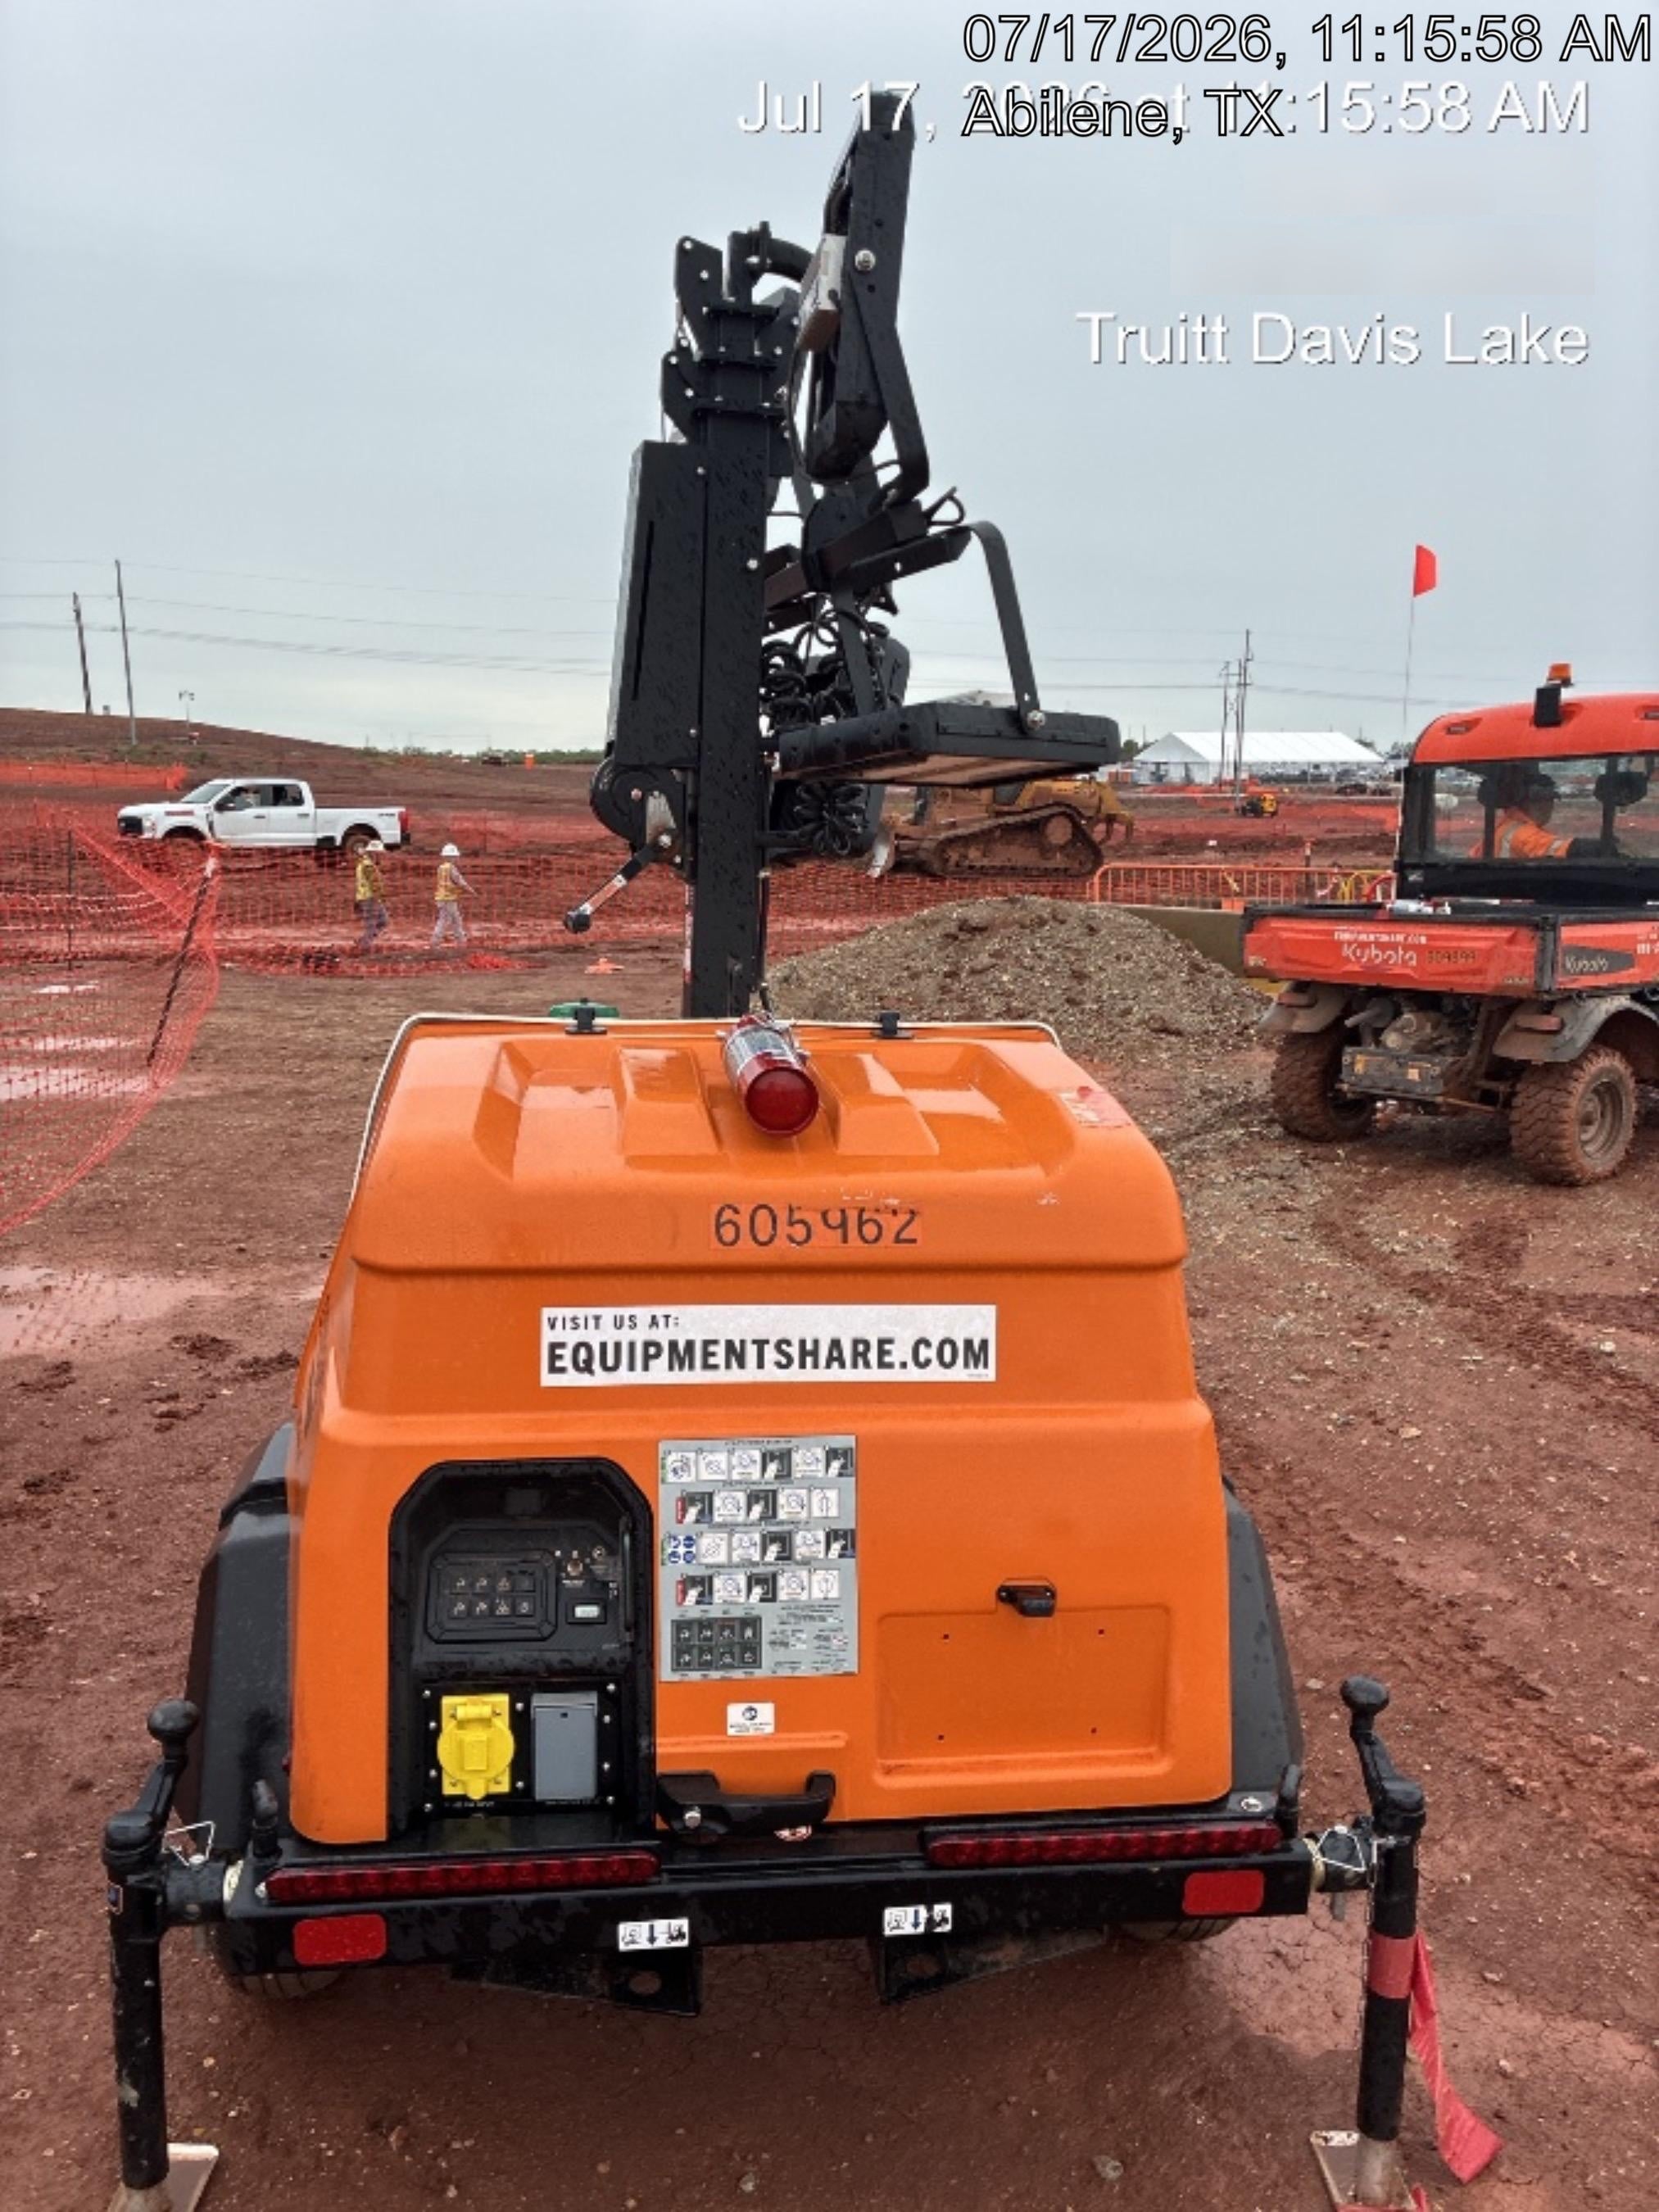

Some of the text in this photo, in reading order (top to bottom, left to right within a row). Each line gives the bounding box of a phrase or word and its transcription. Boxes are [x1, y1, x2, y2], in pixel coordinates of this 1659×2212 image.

[1341, 943, 1417, 967] Kubota
[547, 1312, 681, 1331] VISIT US AT:
[546, 1336, 990, 1376] EQUIPMENTSHARE.COM
